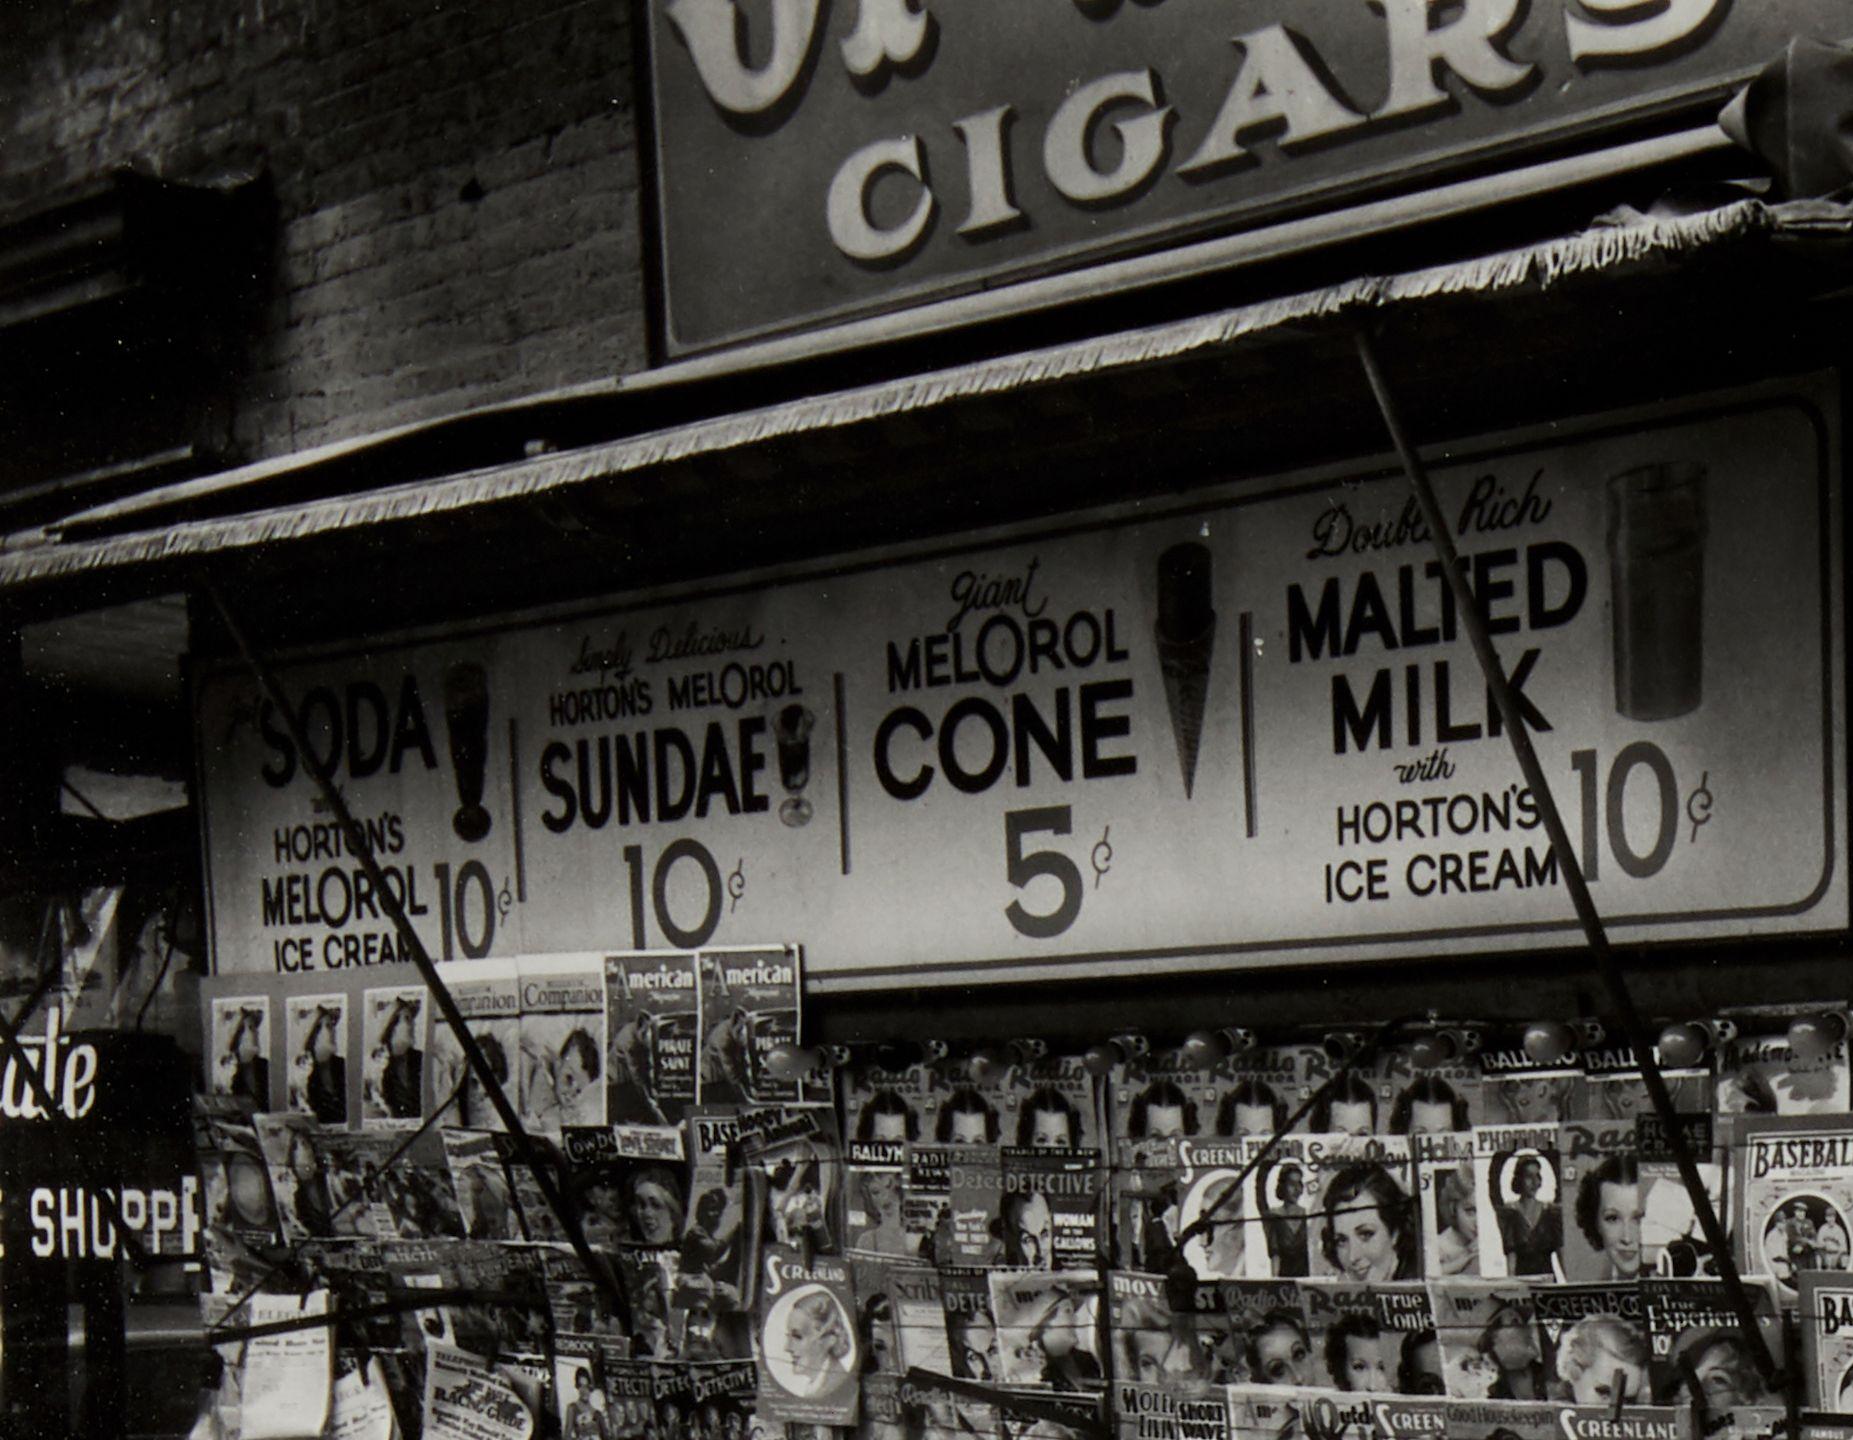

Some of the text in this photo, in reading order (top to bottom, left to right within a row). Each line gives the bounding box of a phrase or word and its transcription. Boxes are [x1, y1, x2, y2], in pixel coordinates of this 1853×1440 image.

[1460, 469, 1552, 535] Rich
[1287, 540, 1587, 664] MALTED
[646, 623, 763, 664] Delicious
[886, 608, 1128, 692] MELOROL
[550, 660, 802, 726] HORTON'S MELOROL
[1331, 649, 1552, 755] MILK
[260, 675, 437, 788] SODA
[874, 678, 1138, 800] CONE
[541, 715, 769, 833] SUNDAE
[1394, 749, 1456, 784] with
[275, 810, 404, 862] HORTON'S
[1337, 783, 1541, 846] HORTON'S
[1569, 741, 1713, 885] 10¢
[262, 865, 427, 928] MELOROL
[624, 838, 745, 950] 10¢
[1005, 804, 1114, 938] 5¢
[1325, 845, 1557, 905] ICE CREAM
[434, 860, 512, 962] 10¢
[275, 939, 312, 972] ICE
[616, 951, 693, 1000] American
[711, 946, 792, 1000] American
[1006, 1174, 1094, 1195] DETECTIVE
[1053, 1213, 1095, 1227] WOMAN
[766, 1255, 846, 1294] SCREENLAND
[1536, 1290, 1602, 1313] SCREEN
[1179, 1402, 1226, 1422] SHORT
[1183, 1423, 1226, 1440] WAVE
